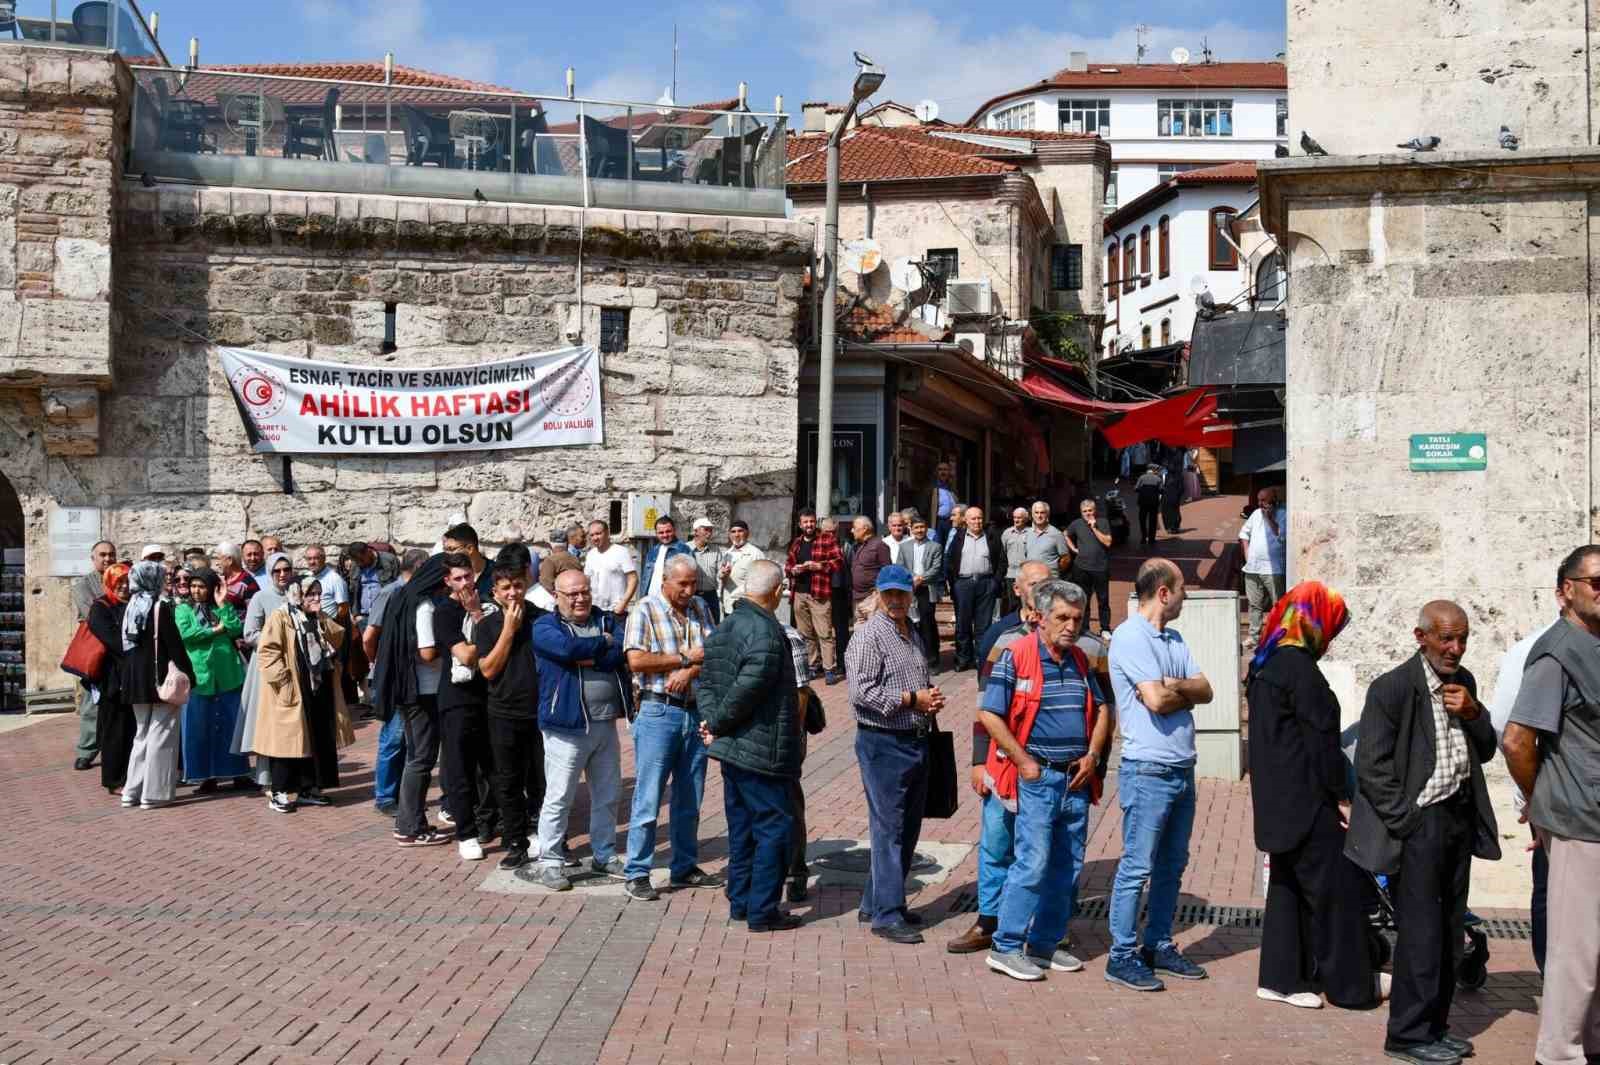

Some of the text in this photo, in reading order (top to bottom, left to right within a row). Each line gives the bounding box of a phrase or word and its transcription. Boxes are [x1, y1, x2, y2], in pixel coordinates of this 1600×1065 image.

[290, 365, 536, 388] ESNAF, TACİR VE SANAYİCİMİZİN
[300, 390, 401, 418] AHİLİK
[411, 389, 530, 416] HAFTASI
[318, 422, 513, 446] KUTLU OLSUN
[544, 420, 562, 431] BOLU
